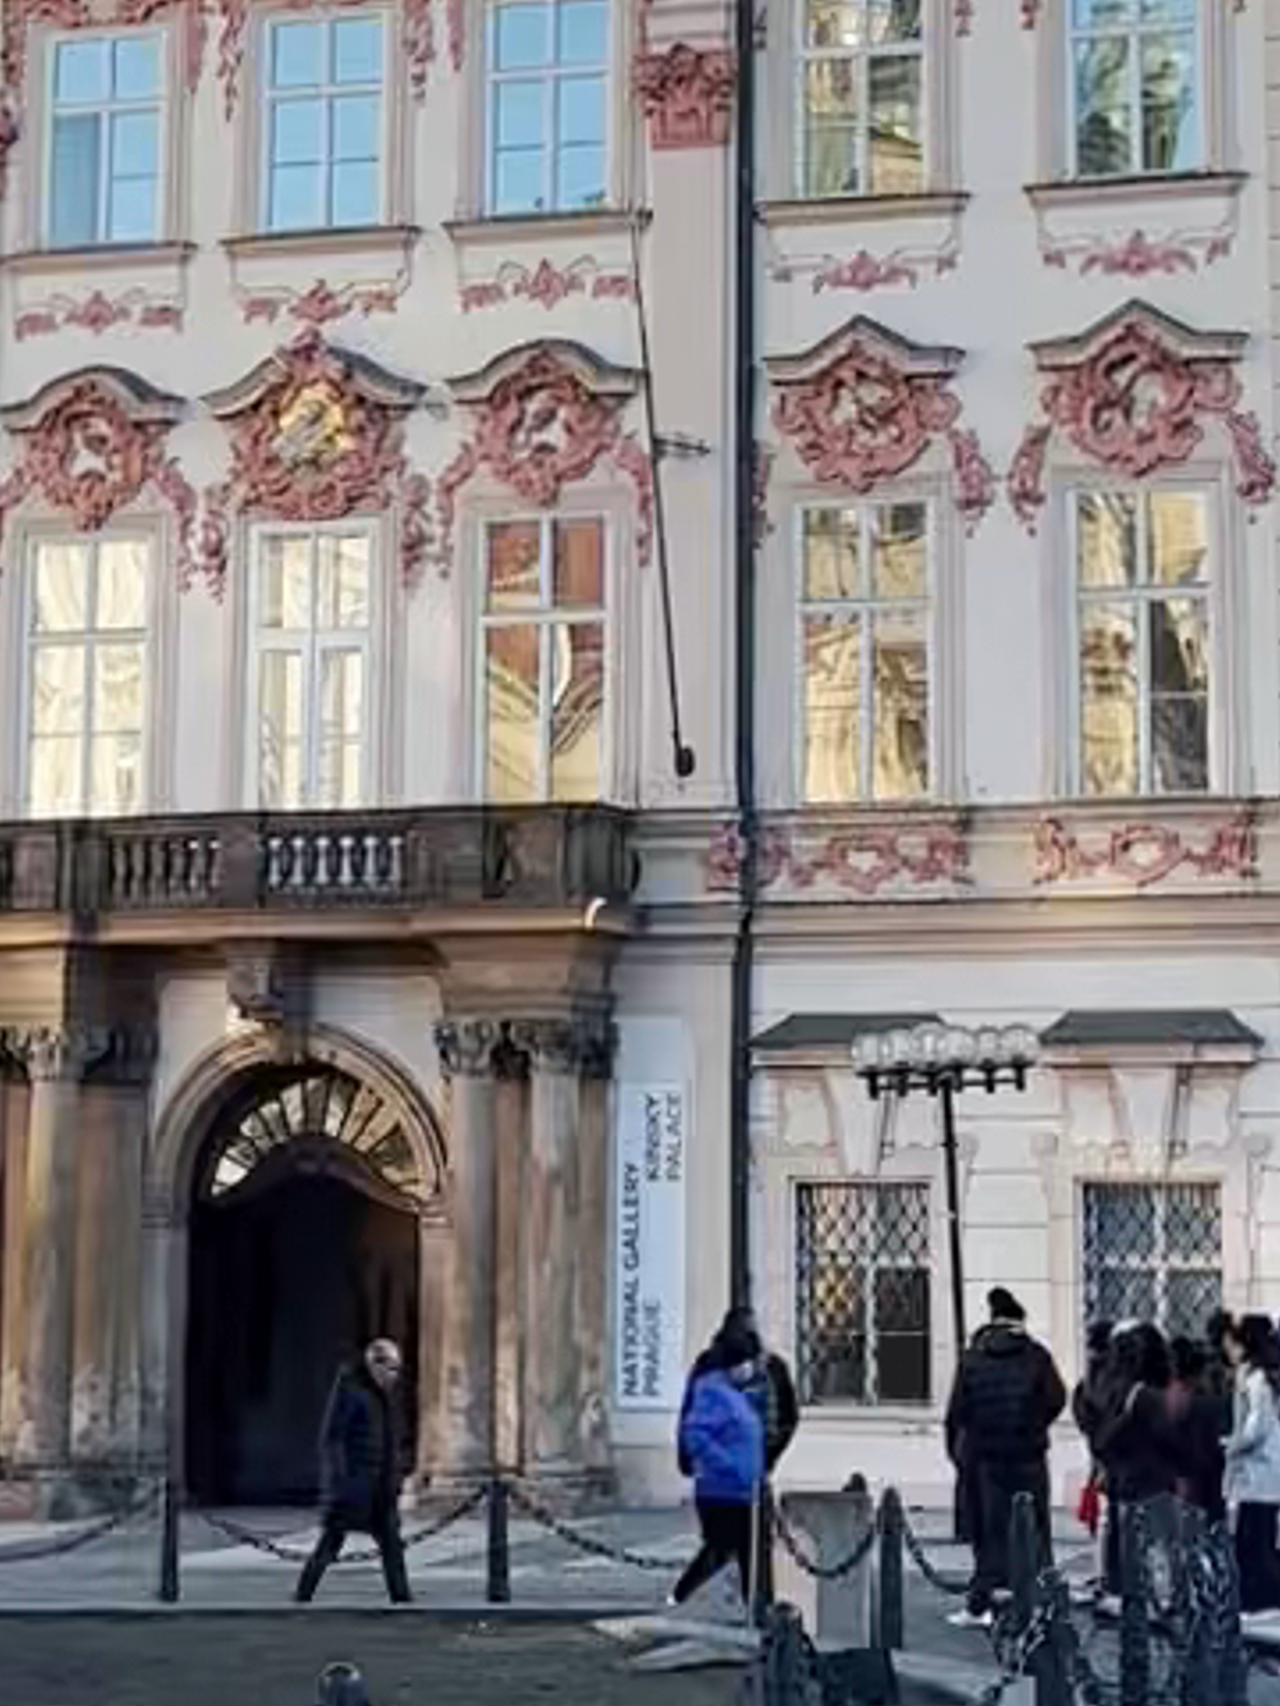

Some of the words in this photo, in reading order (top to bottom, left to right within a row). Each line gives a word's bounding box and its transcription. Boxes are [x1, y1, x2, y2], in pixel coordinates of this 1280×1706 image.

[666, 1094, 681, 1182] PALACE
[622, 1162, 639, 1272] GALLERY
[623, 1276, 639, 1397] NATIONAL
[643, 1299, 660, 1397] PRAGUE
